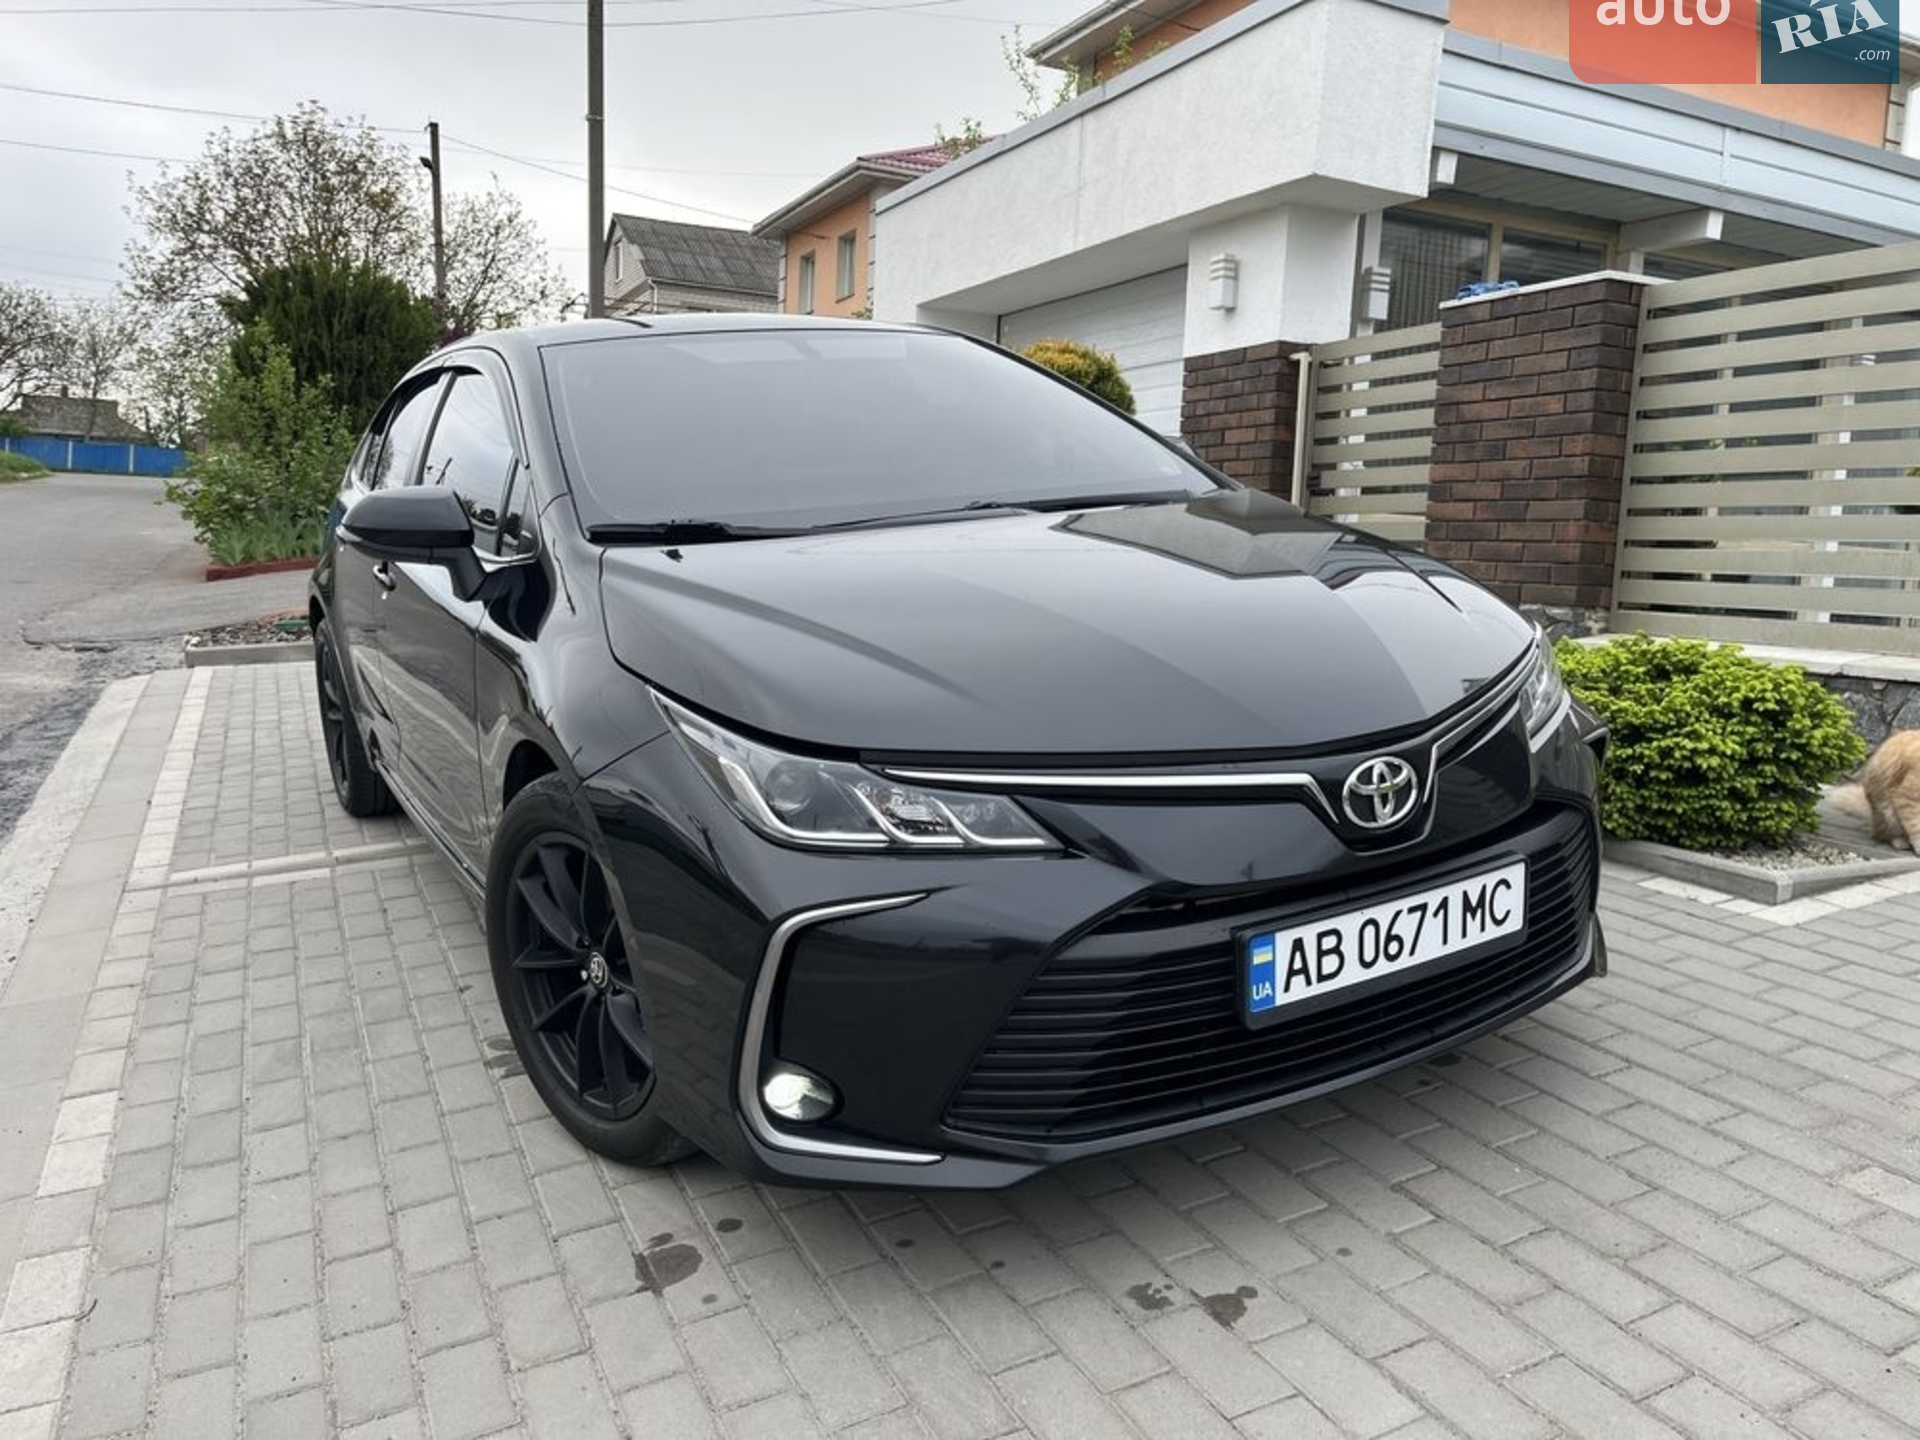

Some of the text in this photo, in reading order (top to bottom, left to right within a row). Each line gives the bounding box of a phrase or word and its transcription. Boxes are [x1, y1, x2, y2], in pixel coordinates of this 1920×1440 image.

[1283, 878, 1512, 993] AB 0671 MC
[1252, 981, 1273, 1000] UA
